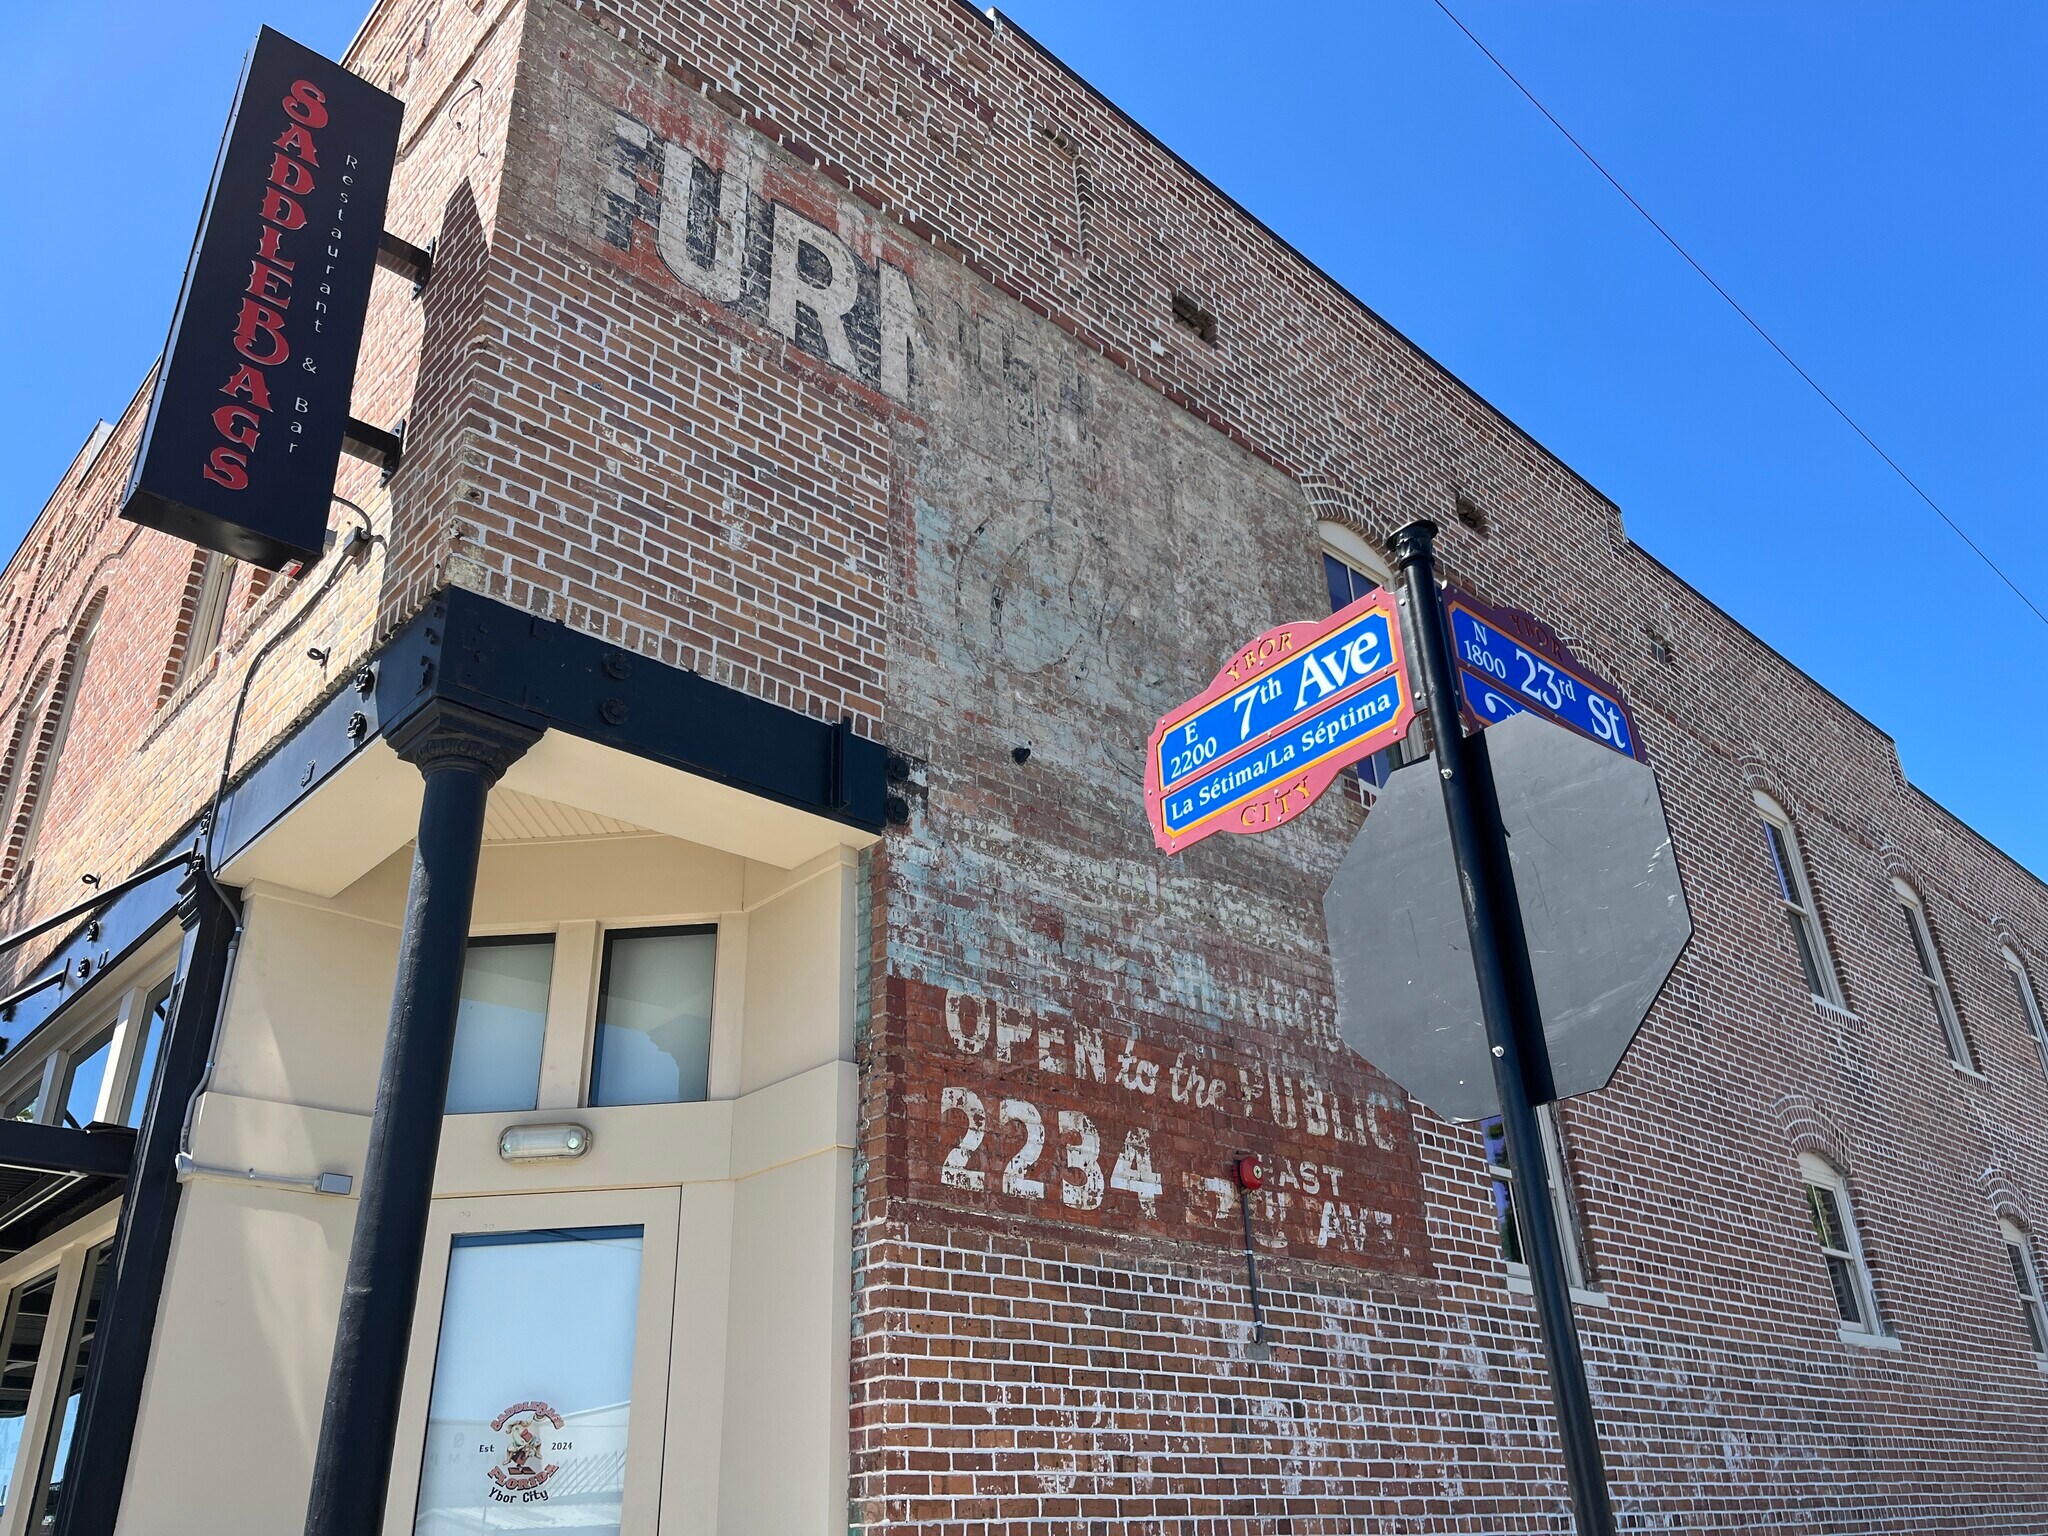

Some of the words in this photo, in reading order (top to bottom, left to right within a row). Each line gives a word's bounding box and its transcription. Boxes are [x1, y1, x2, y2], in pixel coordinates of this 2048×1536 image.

[313, 154, 358, 334] Restaurant
[203, 79, 329, 490] SADDLEBAGS
[302, 356, 317, 374] &
[288, 397, 308, 453] Bar
[1226, 631, 1292, 681] YBOR
[1472, 620, 1487, 646] N
[1184, 721, 1199, 745] E
[1233, 677, 1283, 740] 7th
[1294, 632, 1380, 711] Ave
[1464, 640, 1506, 679] 1800
[1515, 648, 1576, 710] 23rd
[1587, 694, 1625, 749] St
[1170, 737, 1217, 779] 2200
[1171, 795, 1194, 820] La
[1301, 693, 1392, 751] Séptima
[1240, 776, 1311, 826] CITY
[944, 988, 1106, 1083] OPEN
[1117, 1038, 1159, 1096] to
[1170, 1049, 1227, 1109] the
[1239, 1066, 1399, 1151] PUBLIC
[941, 1087, 1162, 1220] 2234
[479, 1444, 495, 1453] Est
[551, 1442, 573, 1451] 2024
[487, 1464, 559, 1491] FLORIDA
[489, 1487, 517, 1503] Ybor
[523, 1489, 549, 1503] City
